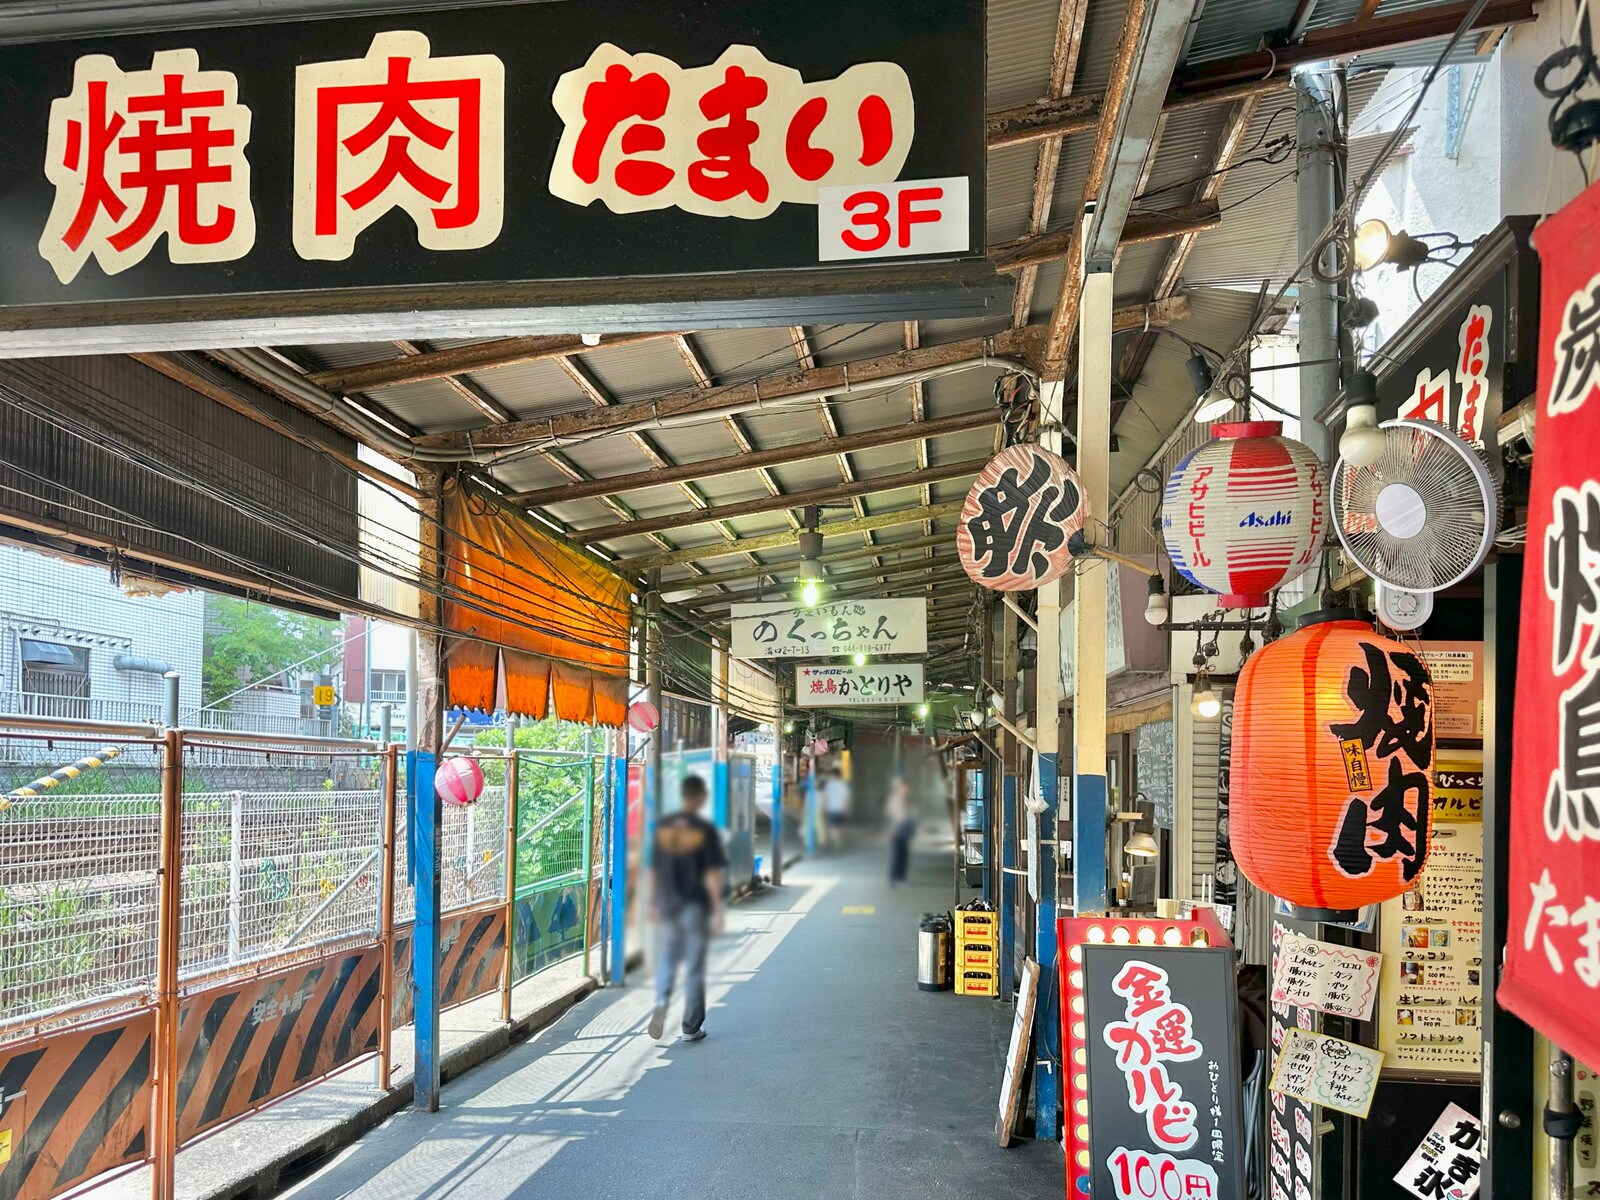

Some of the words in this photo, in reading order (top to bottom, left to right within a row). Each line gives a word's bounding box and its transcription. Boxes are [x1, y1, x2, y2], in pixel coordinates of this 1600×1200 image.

[62, 56, 482, 253] 焼肉
[571, 64, 893, 197] たまい
[840, 187, 944, 251] 3F
[1187, 465, 1214, 568] アサヒビール
[1238, 509, 1293, 529] Asahi
[1296, 463, 1325, 566] アサヒビール
[752, 614, 898, 643] のくっちゃん
[809, 677, 837, 695] 焼鳥
[838, 673, 913, 697] かとりや
[811, 668, 853, 676] サッポロビール
[317, 689, 334, 703] 19
[1329, 642, 1436, 882] 焼肉
[1345, 742, 1369, 789] 味自慢
[1433, 795, 1483, 810] カルビ
[1399, 994, 1447, 1006] 生ビール
[1399, 1033, 1464, 1043] ソフトドリンク
[1114, 1151, 1212, 1200] 100円
